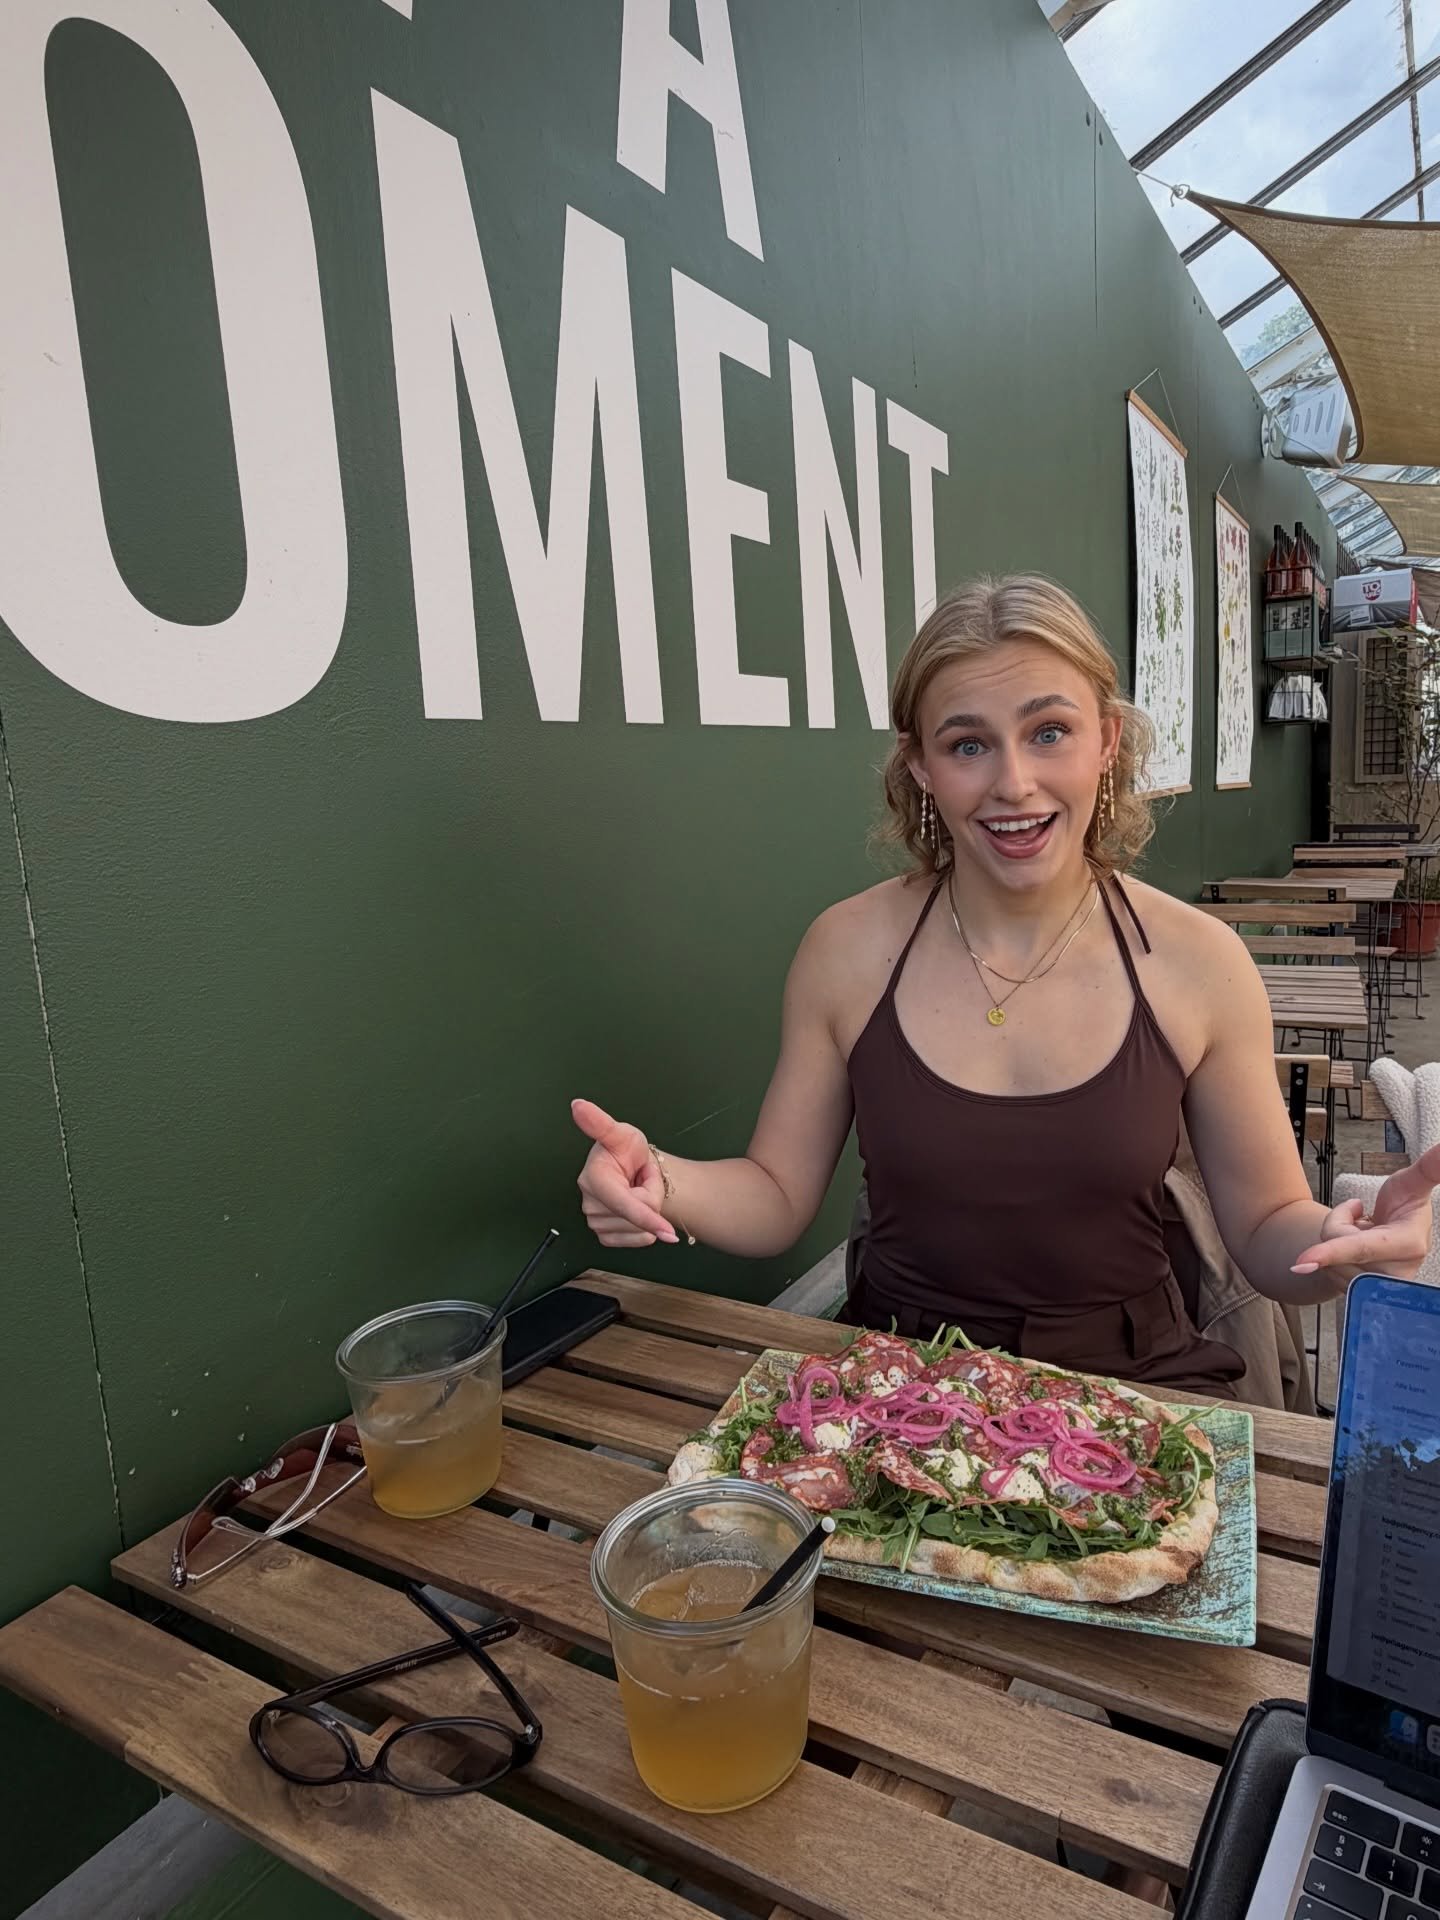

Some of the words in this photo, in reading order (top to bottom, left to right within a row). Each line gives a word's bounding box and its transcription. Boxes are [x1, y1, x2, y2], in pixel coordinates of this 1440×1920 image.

[617, 0, 764, 262] A
[1332, 1811, 1348, 1821] esc
[1387, 1870, 1395, 1881] 1
